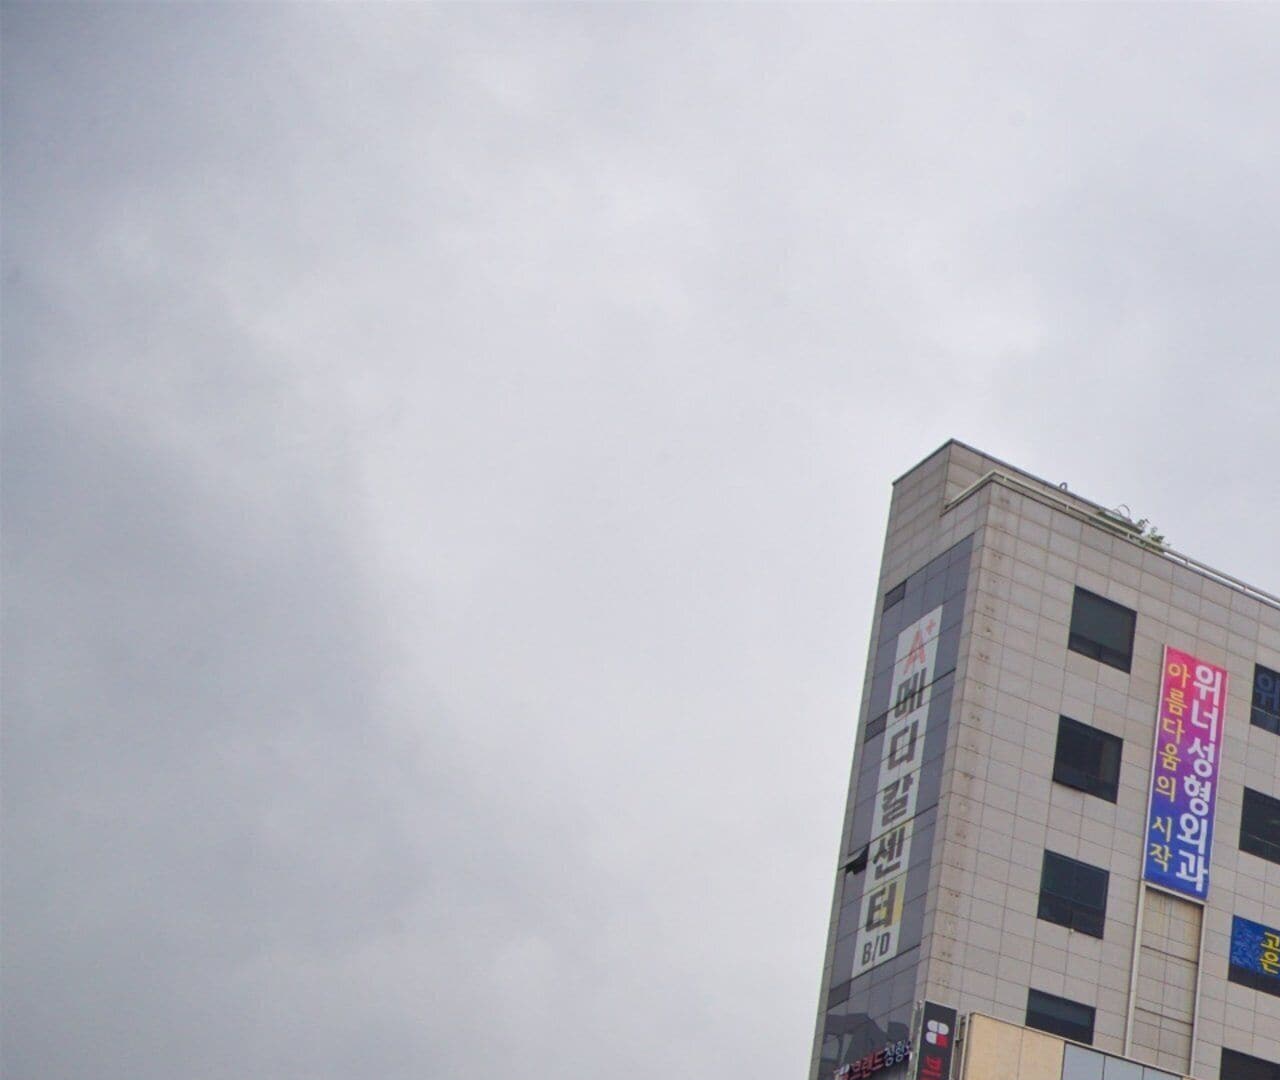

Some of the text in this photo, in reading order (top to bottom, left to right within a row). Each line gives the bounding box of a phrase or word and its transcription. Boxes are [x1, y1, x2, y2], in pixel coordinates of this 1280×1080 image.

[1149, 663, 1191, 873] 아름다움의 시작
[861, 933, 891, 967] B/D
